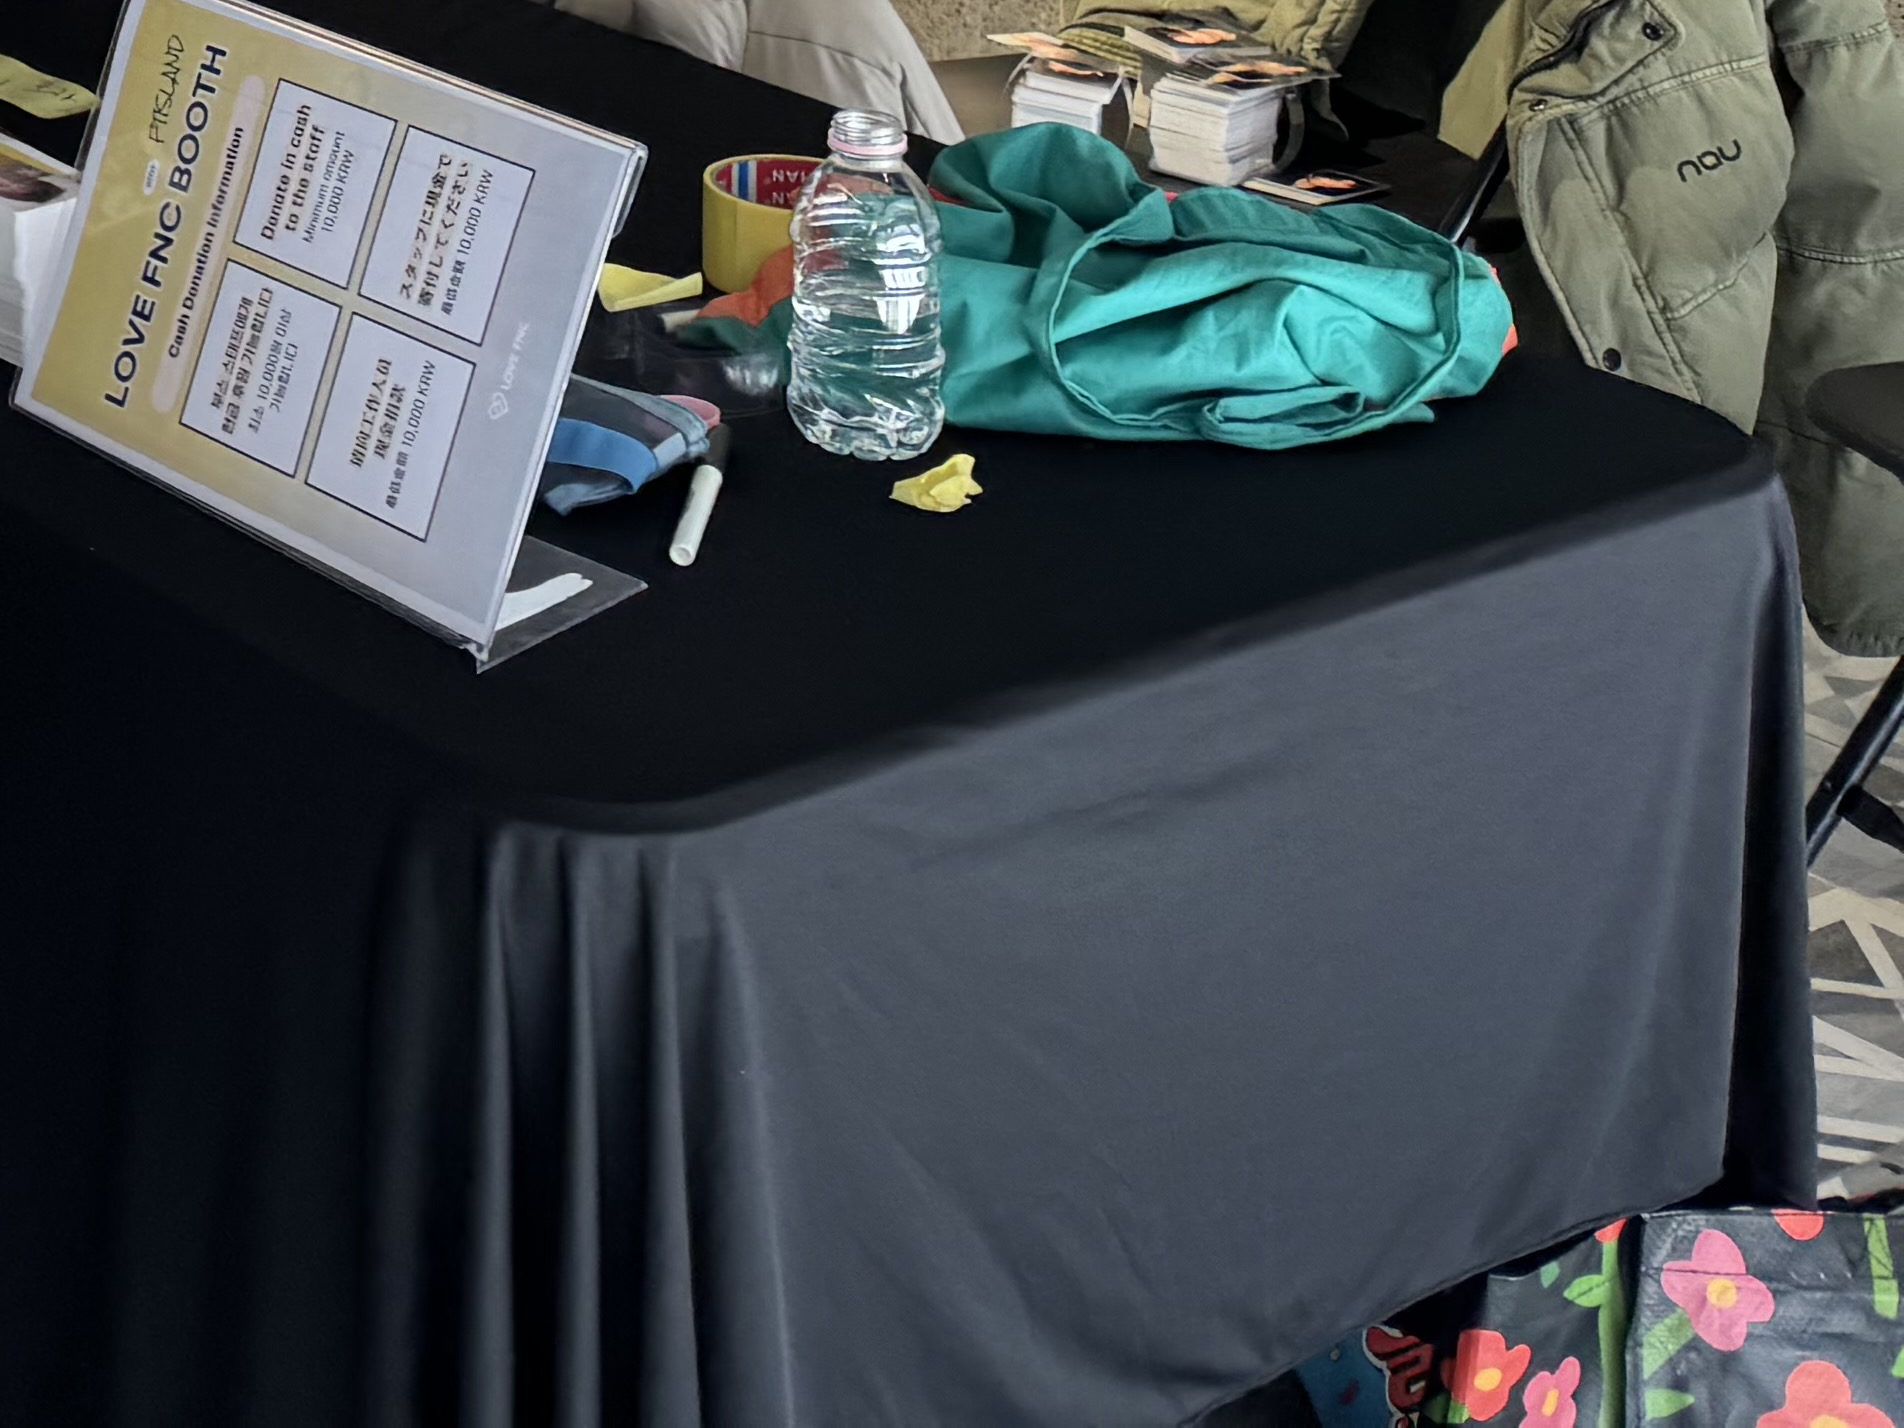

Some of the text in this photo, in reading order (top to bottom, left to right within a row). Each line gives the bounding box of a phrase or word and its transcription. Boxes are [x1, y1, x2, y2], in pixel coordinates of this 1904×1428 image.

[260, 103, 312, 241] Donate in cash
[285, 124, 326, 232] to the staff
[302, 184, 330, 244] Minimum
[321, 149, 356, 233] 10,000 KRW
[456, 169, 494, 256] 10,000 KRW
[104, 44, 227, 408] LOVE FNC BOOTH
[168, 126, 244, 359] Cash Donation Information
[402, 360, 436, 446] 10,000 KRW
